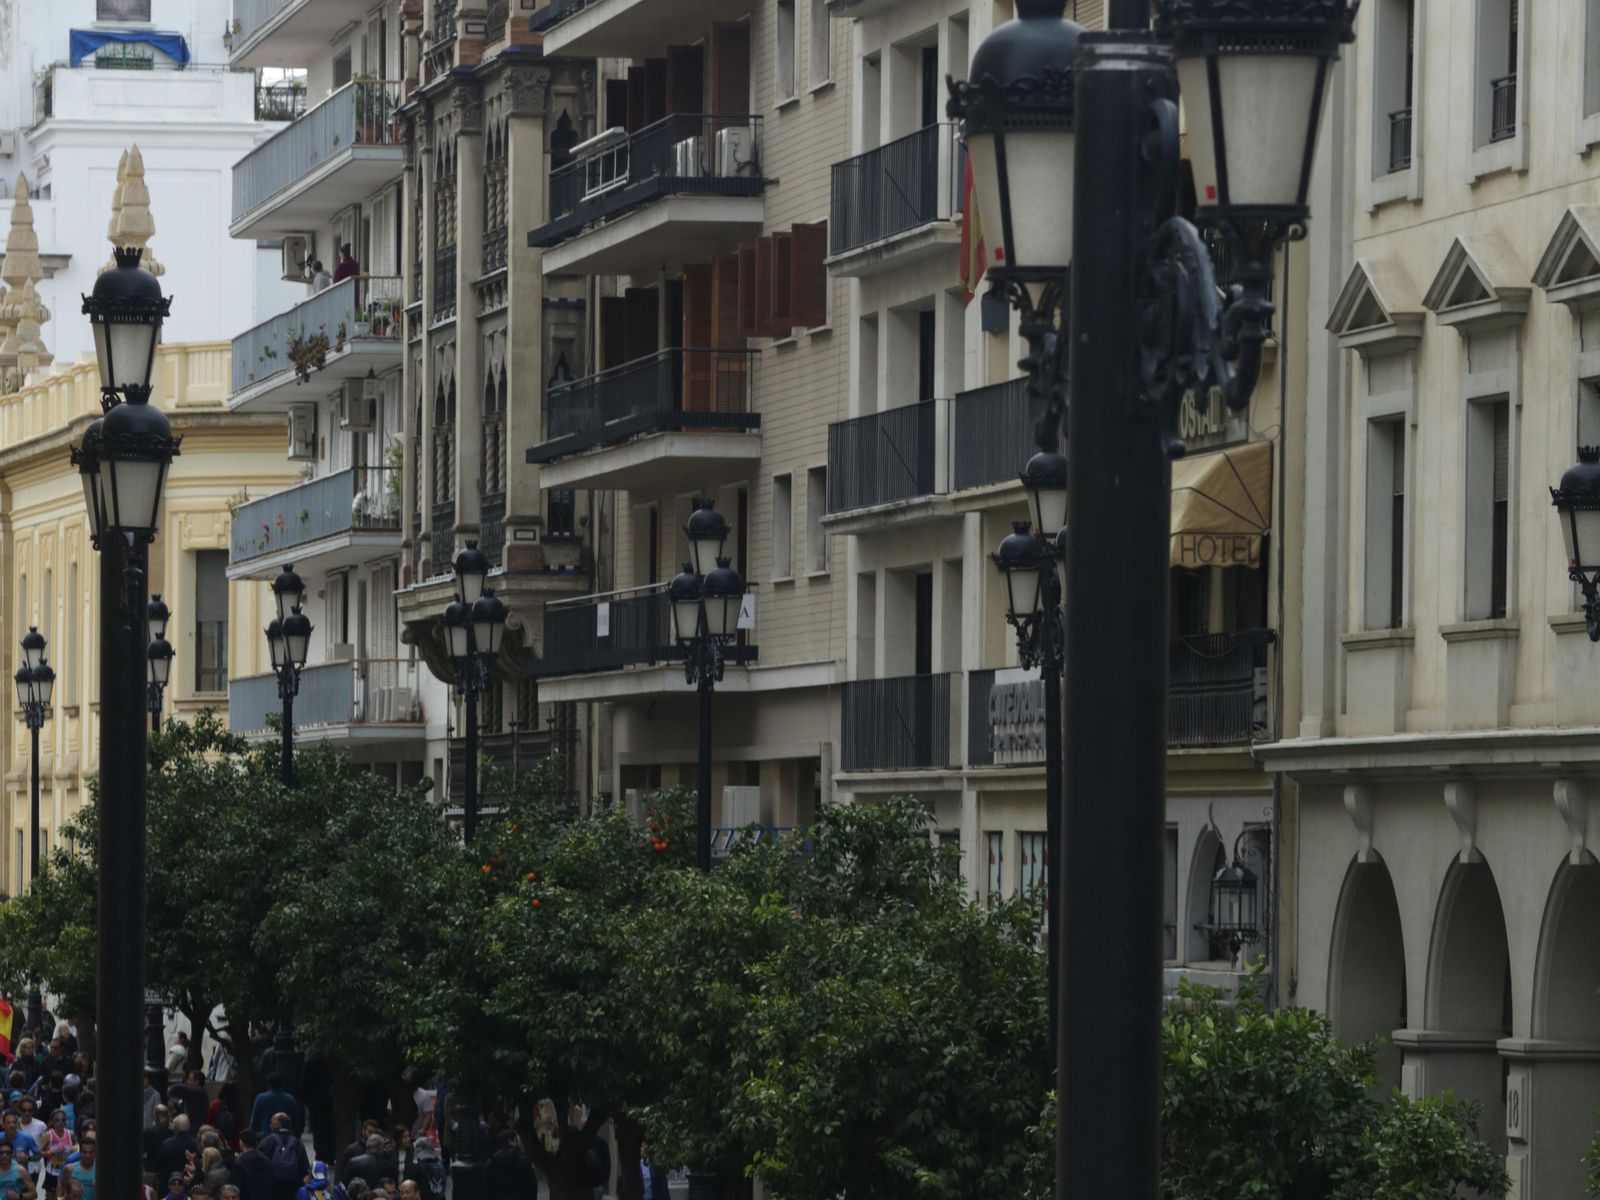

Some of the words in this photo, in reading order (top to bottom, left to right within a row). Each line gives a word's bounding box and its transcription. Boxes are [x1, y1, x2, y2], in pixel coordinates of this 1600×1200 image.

[1180, 386, 1219, 439] OSTAL
[1181, 534, 1260, 563] HOTEL
[1508, 1089, 1519, 1128] 18
